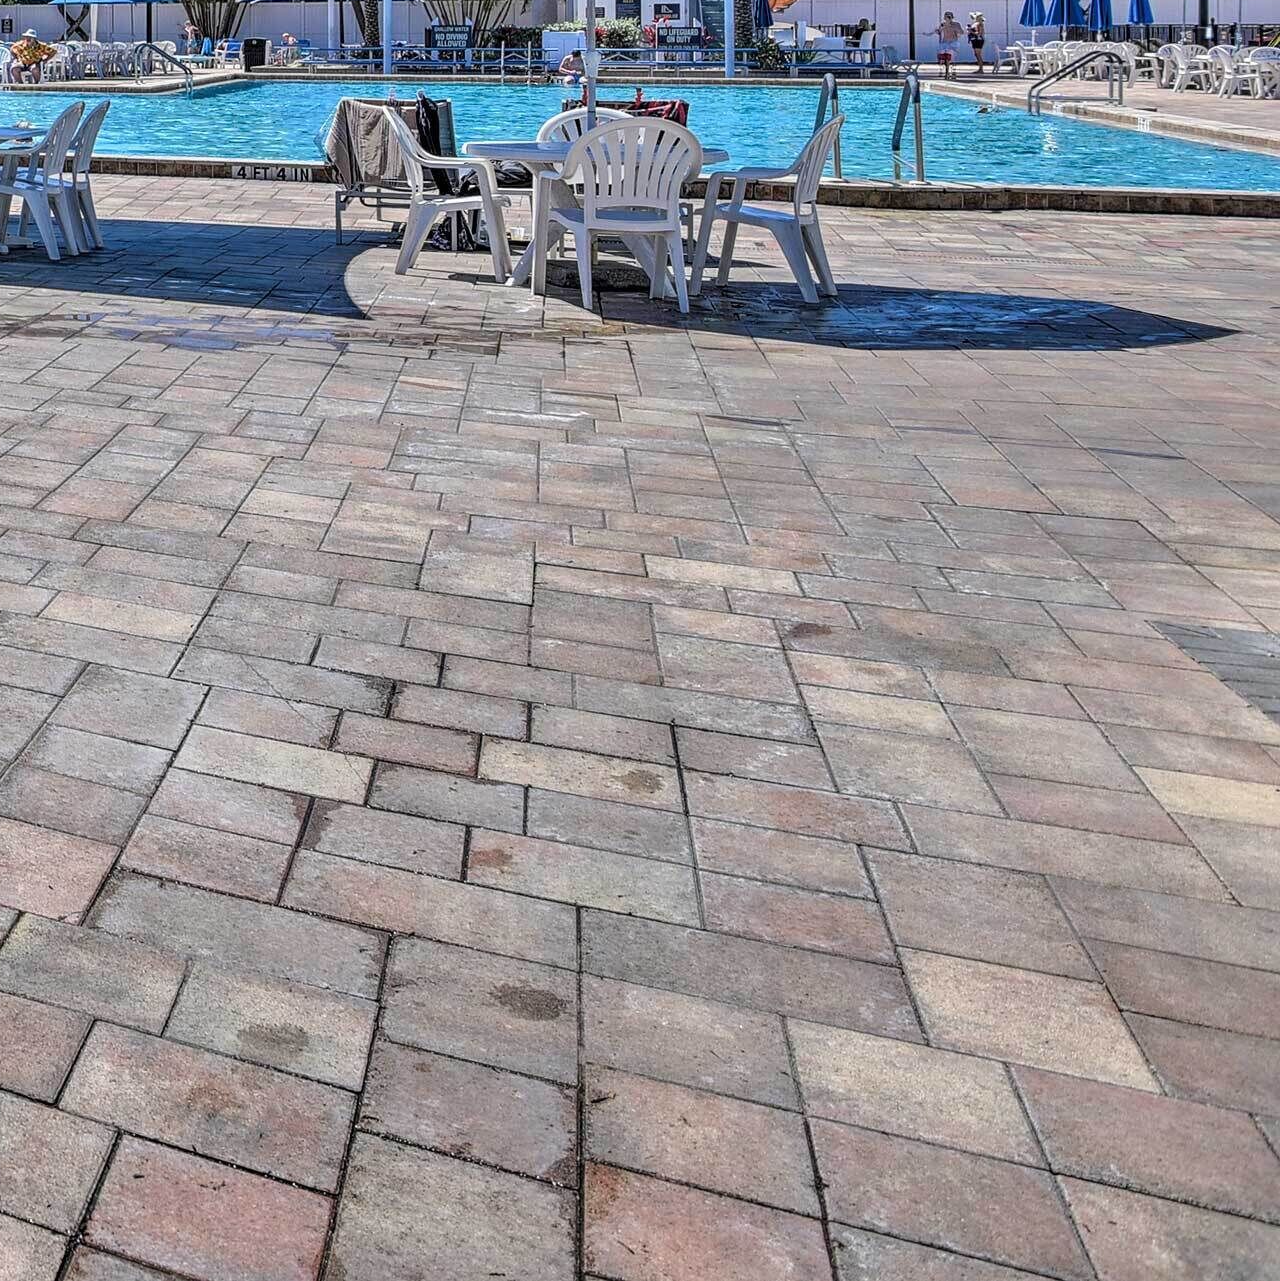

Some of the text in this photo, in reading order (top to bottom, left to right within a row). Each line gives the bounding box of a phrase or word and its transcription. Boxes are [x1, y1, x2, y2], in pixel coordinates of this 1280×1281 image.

[659, 28, 699, 36] NO LIFEGUARD
[237, 166, 309, 182] 4 FT 4 IN
